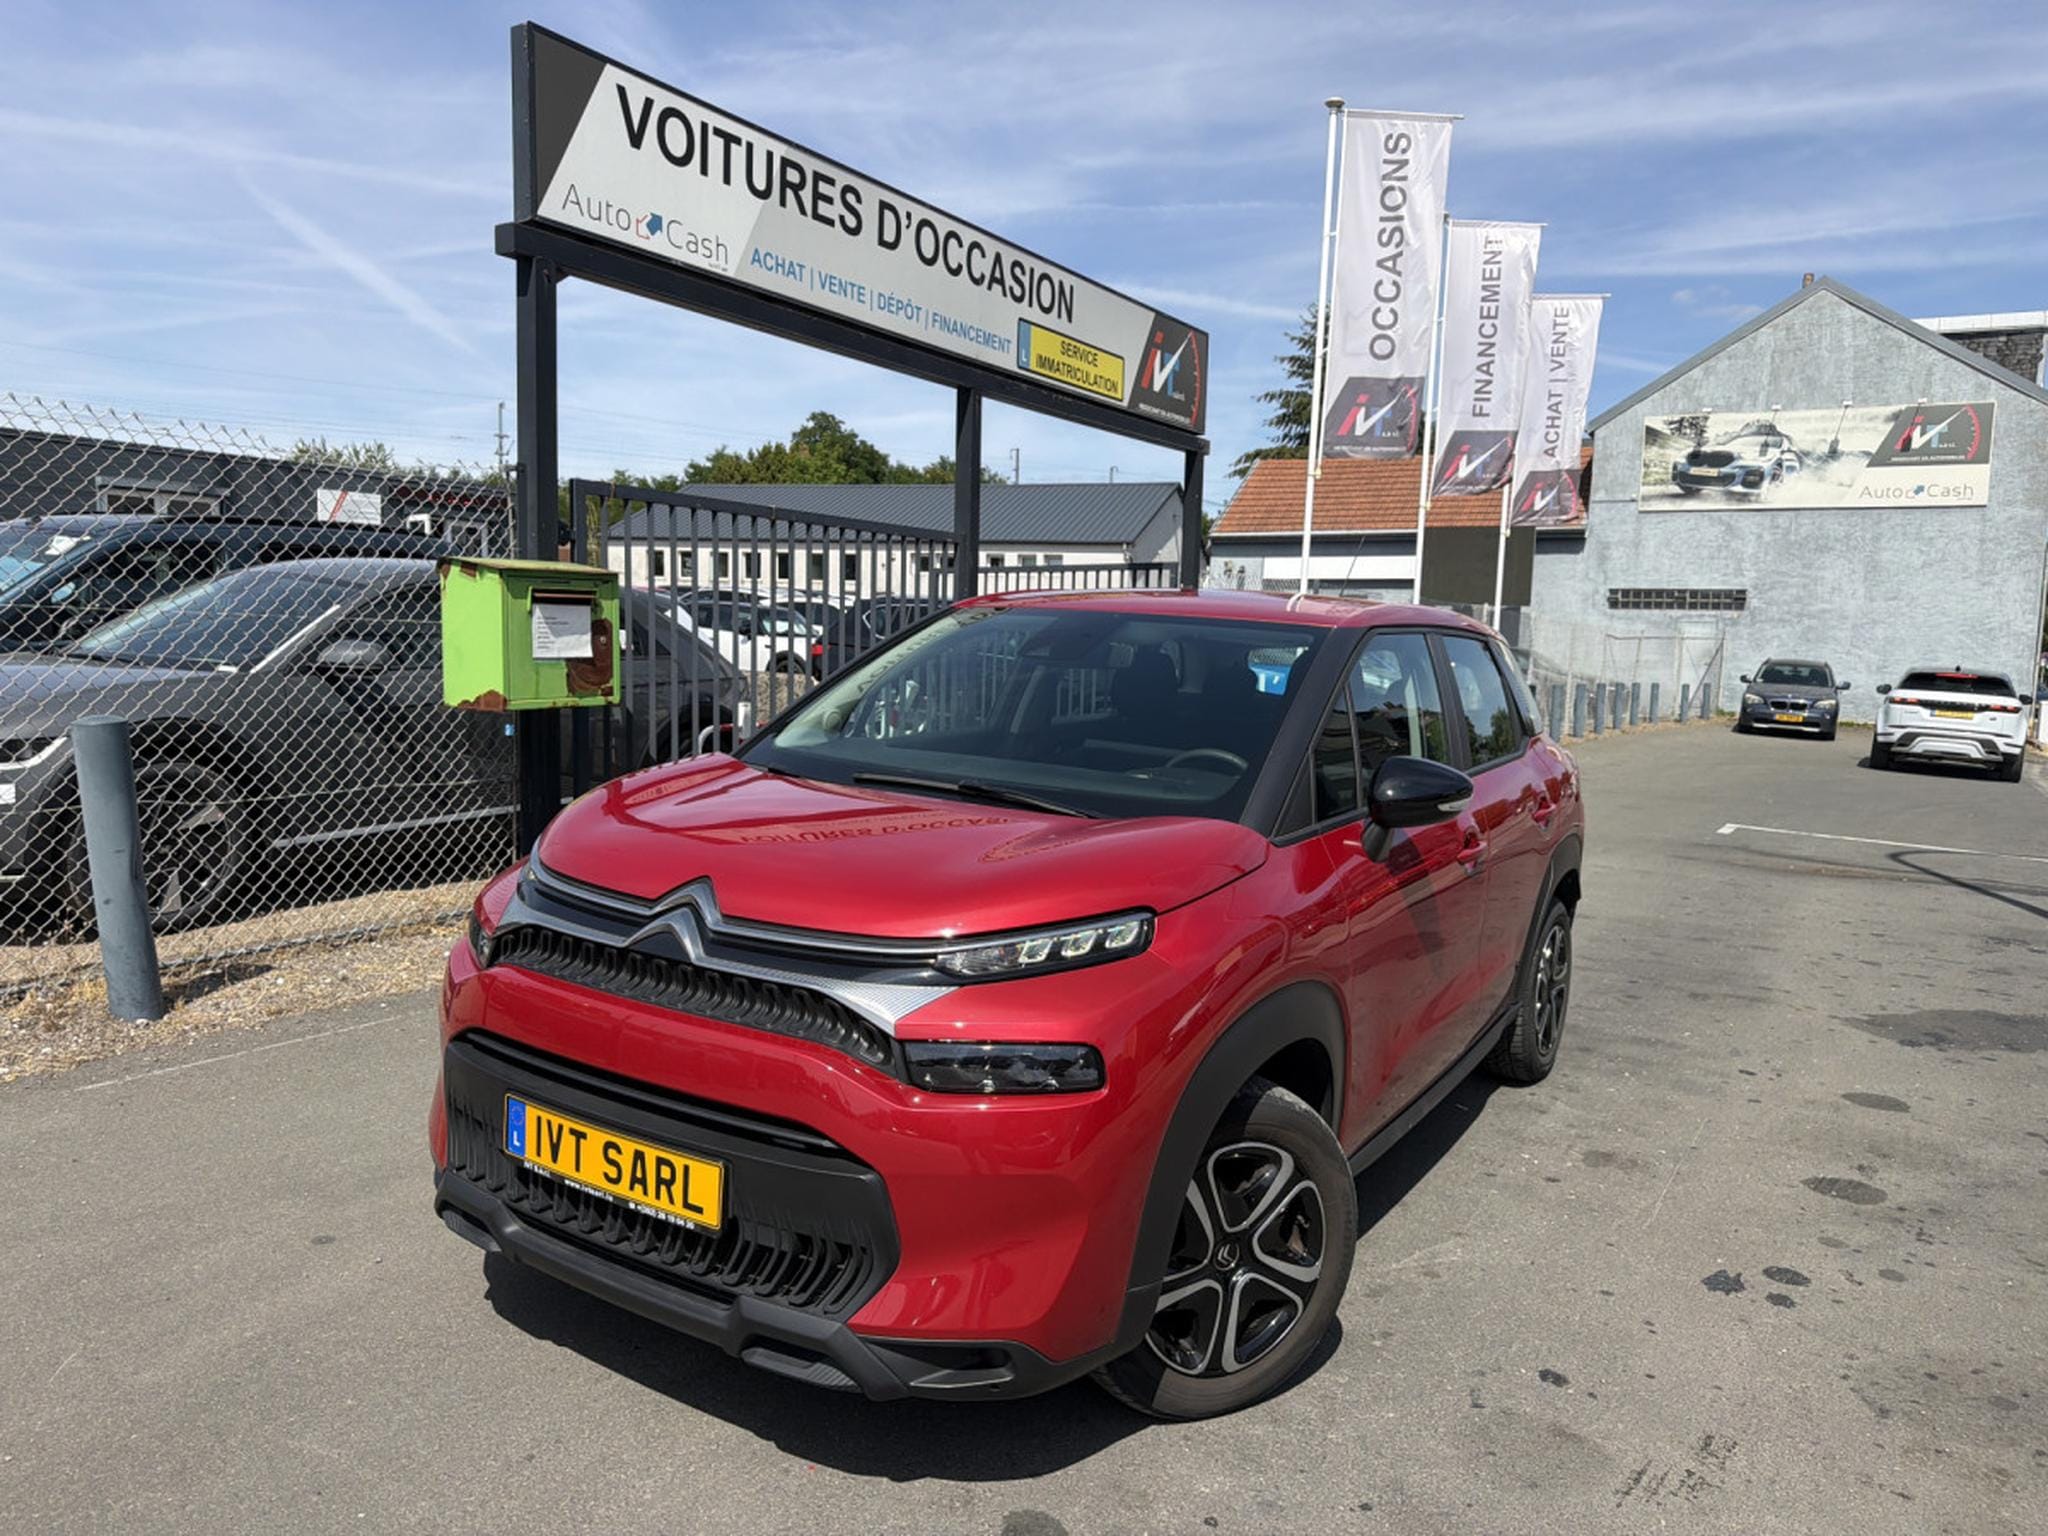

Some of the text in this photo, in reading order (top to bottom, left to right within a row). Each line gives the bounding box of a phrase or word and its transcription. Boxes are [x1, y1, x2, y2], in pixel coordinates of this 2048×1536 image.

[562, 183, 729, 264] Auto Cash
[616, 83, 1074, 323] VOITURES D'OCCASION
[1369, 131, 1412, 361] OCCASIONS
[751, 247, 1013, 354] ACHAT VENTE DÉPÔT FINANCEMENT
[1472, 235, 1503, 418] FINANCEMENT
[1036, 353, 1119, 393] IMMATRICULATION
[1060, 340, 1099, 368] SERVICE
[1544, 306, 1570, 460] ACHAT VENTE
[1859, 483, 1975, 499] Auto Cash
[513, 1130, 521, 1147] L
[536, 1115, 704, 1215] IVT SARL
